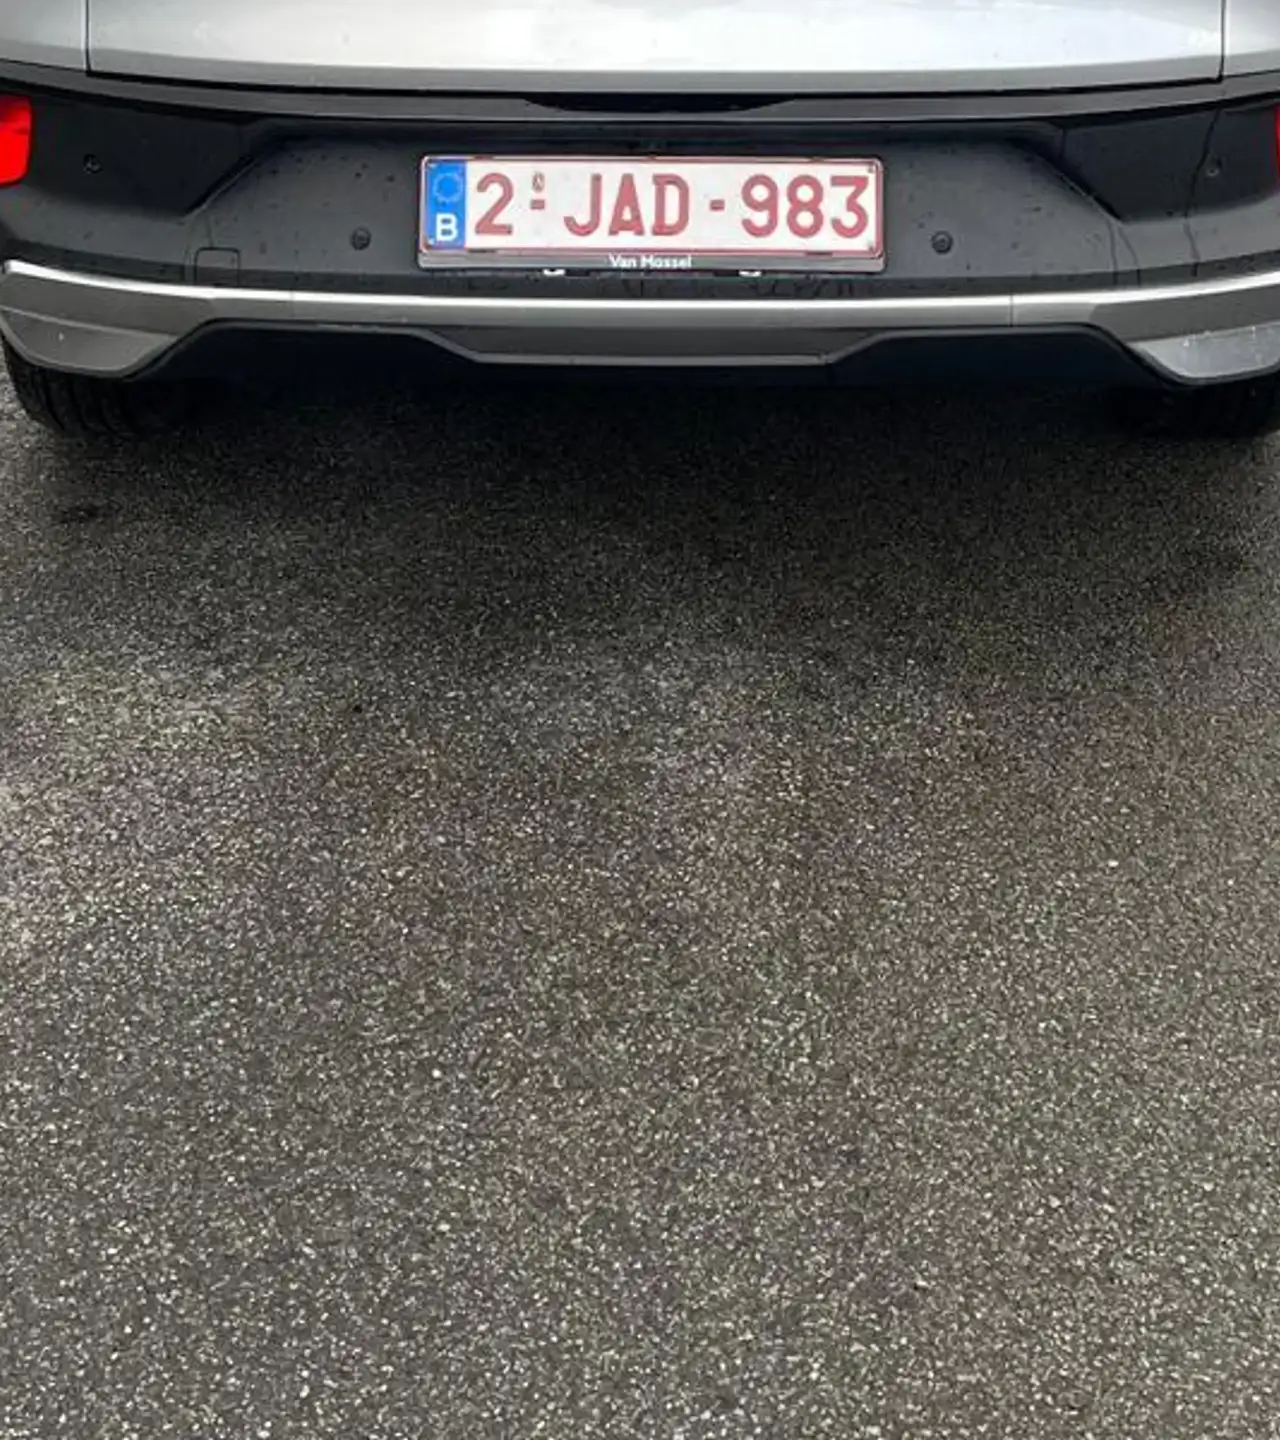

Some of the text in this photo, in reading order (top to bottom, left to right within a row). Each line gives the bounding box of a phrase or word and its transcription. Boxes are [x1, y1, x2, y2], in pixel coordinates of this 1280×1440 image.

[474, 172, 870, 238] 2-JAD-983
[436, 213, 458, 241] B
[608, 252, 637, 268] Van
